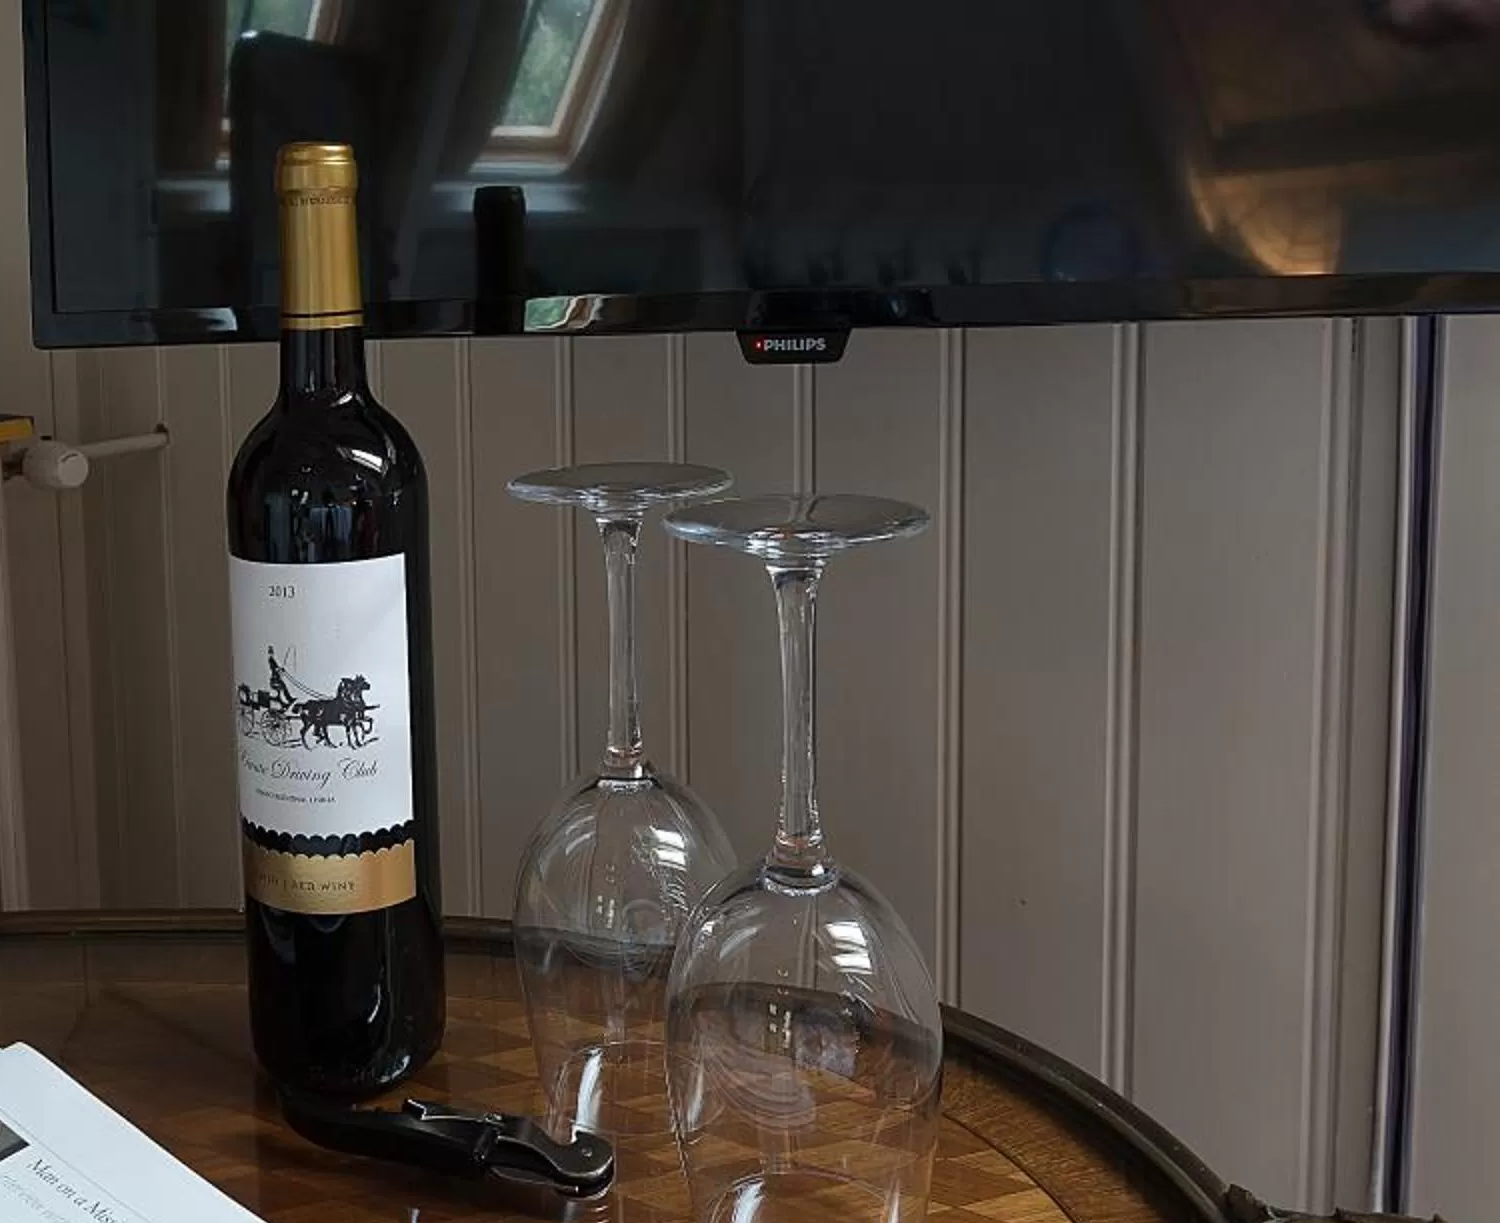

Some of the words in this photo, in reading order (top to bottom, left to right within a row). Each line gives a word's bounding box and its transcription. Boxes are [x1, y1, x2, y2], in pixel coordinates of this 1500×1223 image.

[763, 337, 827, 351] PHILIPS
[267, 585, 296, 599] 2013
[270, 757, 332, 789] Driving
[337, 757, 380, 782] Club
[320, 880, 357, 892] WINE
[27, 1158, 58, 1187] Man
[58, 1184, 78, 1201] on
